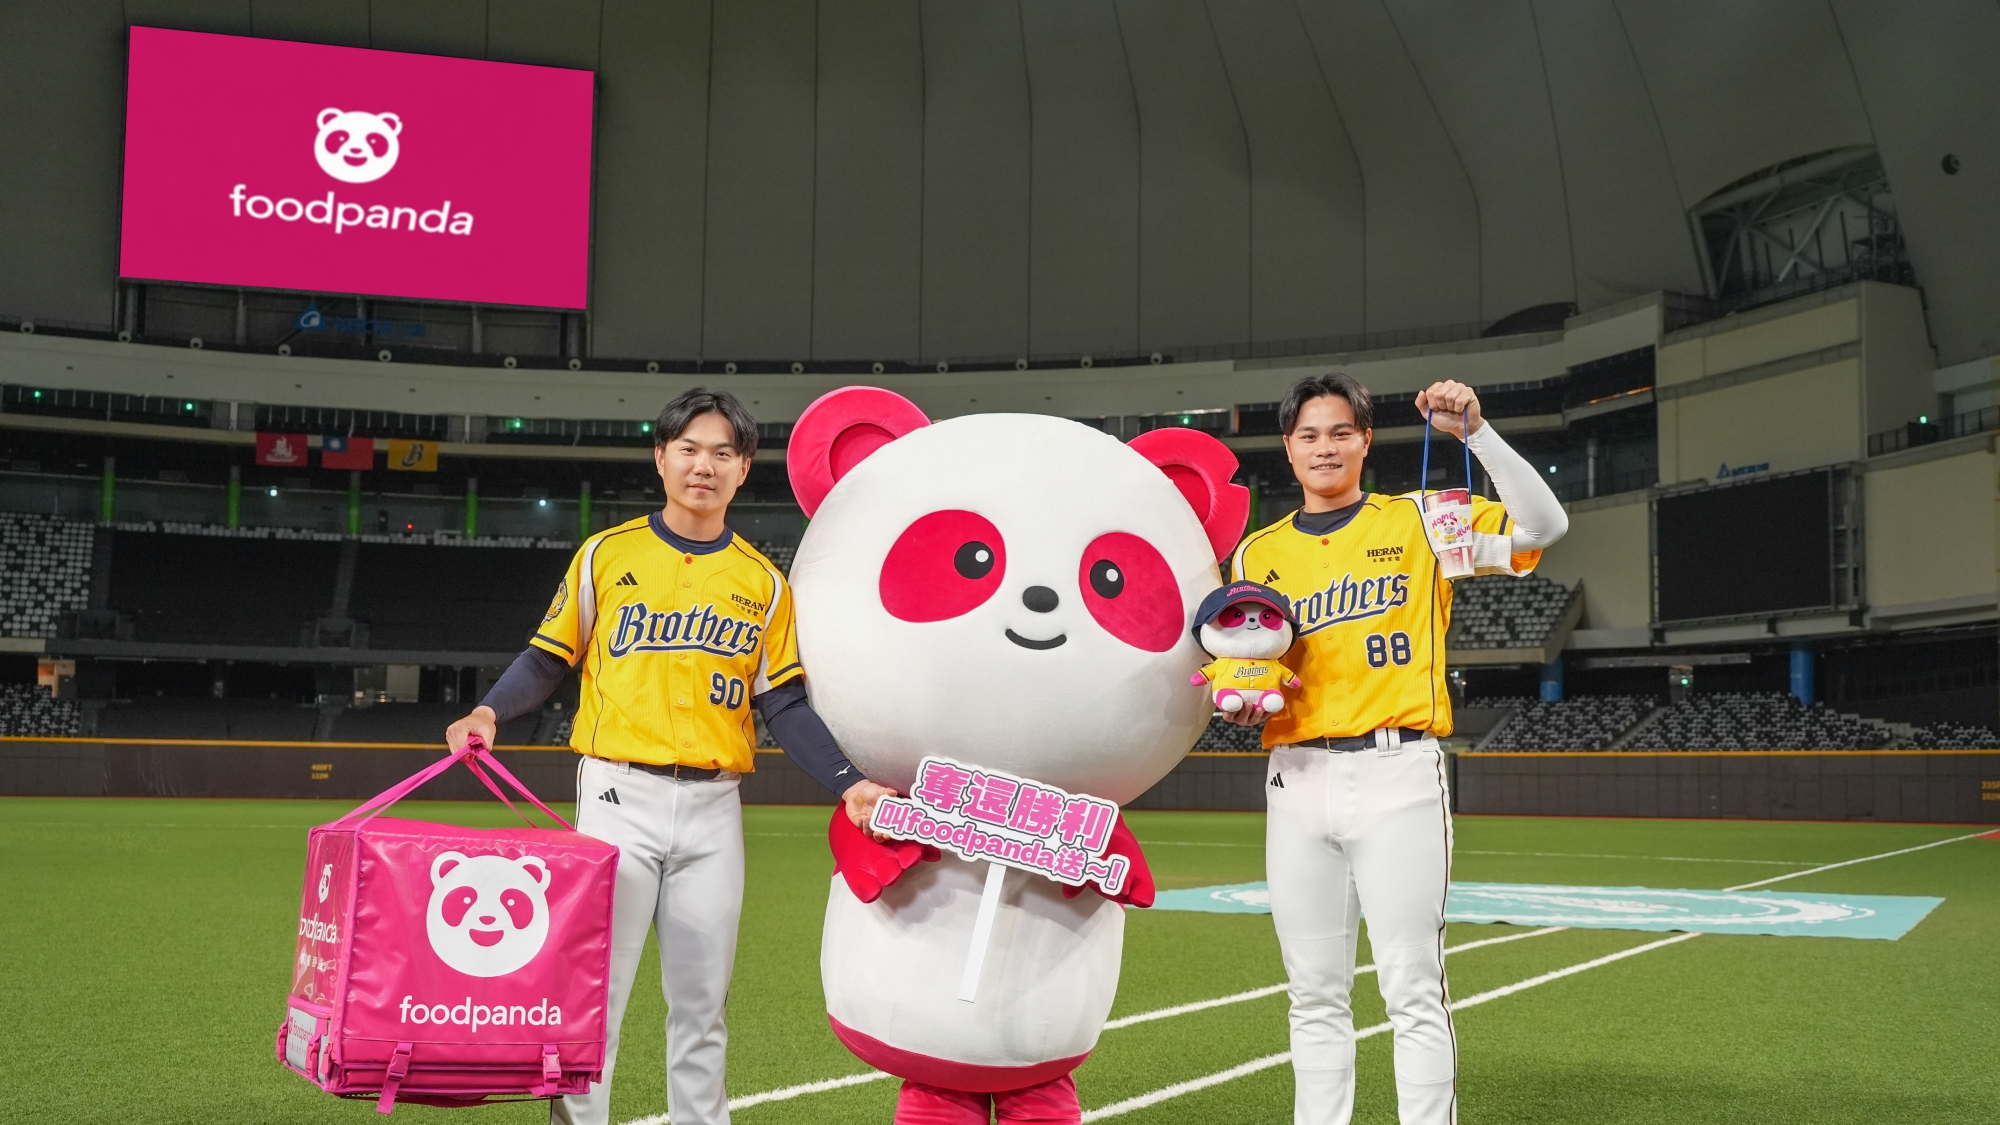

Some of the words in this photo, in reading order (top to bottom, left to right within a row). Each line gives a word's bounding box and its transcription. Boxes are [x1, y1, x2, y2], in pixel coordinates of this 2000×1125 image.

[229, 184, 474, 236] foodpanda
[1366, 546, 1404, 558] HERAN
[731, 593, 766, 612] HERAN
[1226, 585, 1262, 597] Brothers
[1283, 572, 1411, 637] rothers
[609, 602, 764, 658] Brothers
[1365, 632, 1411, 668] 88
[1234, 665, 1269, 679] Brothers
[709, 672, 745, 711] 90
[915, 762, 1112, 850] 奪還勝利
[398, 995, 562, 1033] foodpanda
